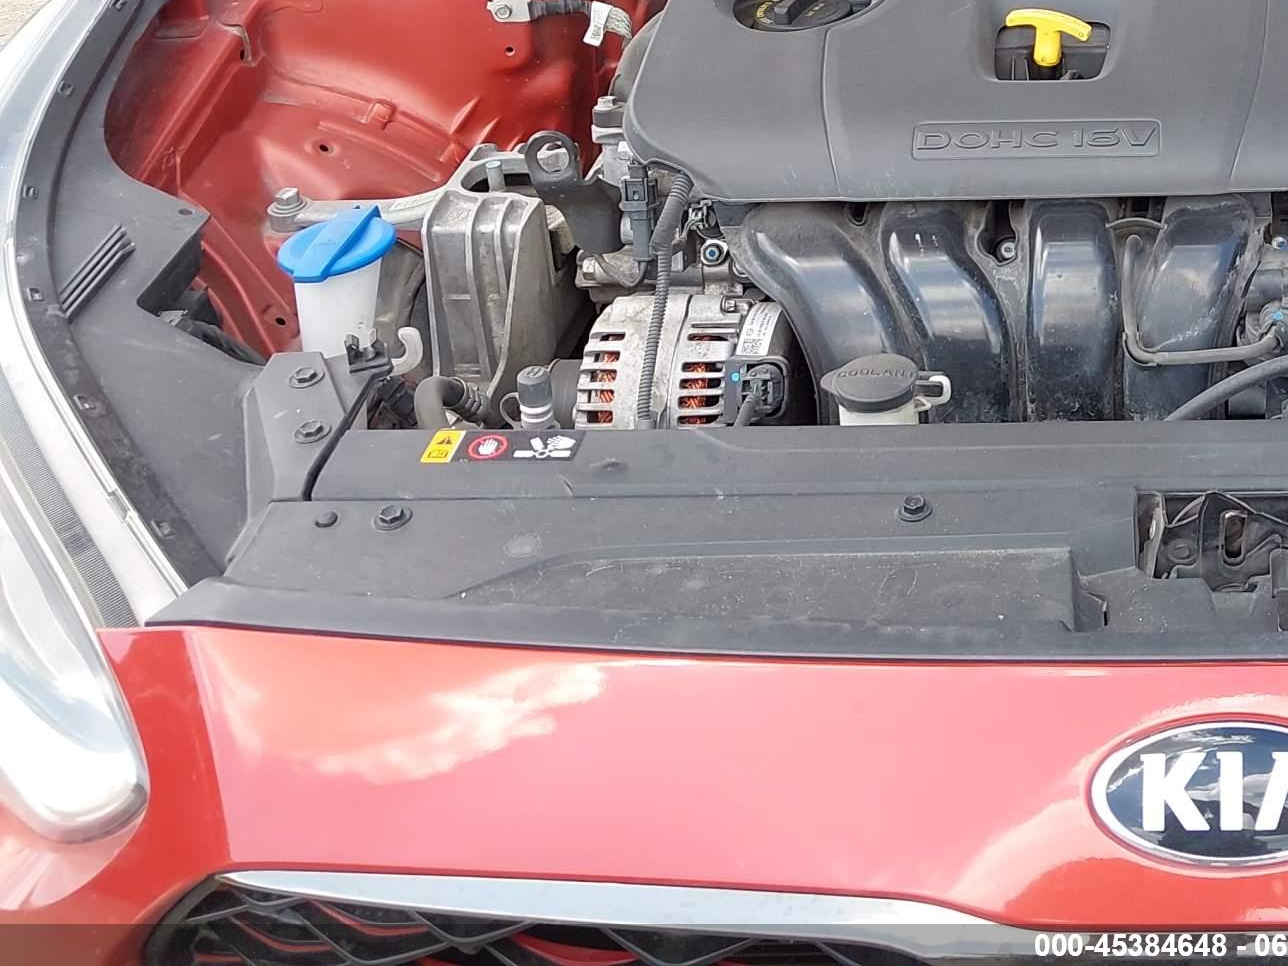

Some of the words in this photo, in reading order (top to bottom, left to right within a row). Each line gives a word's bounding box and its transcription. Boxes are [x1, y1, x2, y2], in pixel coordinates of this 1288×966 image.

[916, 129, 1060, 150] DOHC
[1072, 127, 1157, 148] 16V
[837, 369, 914, 379] COOLANT
